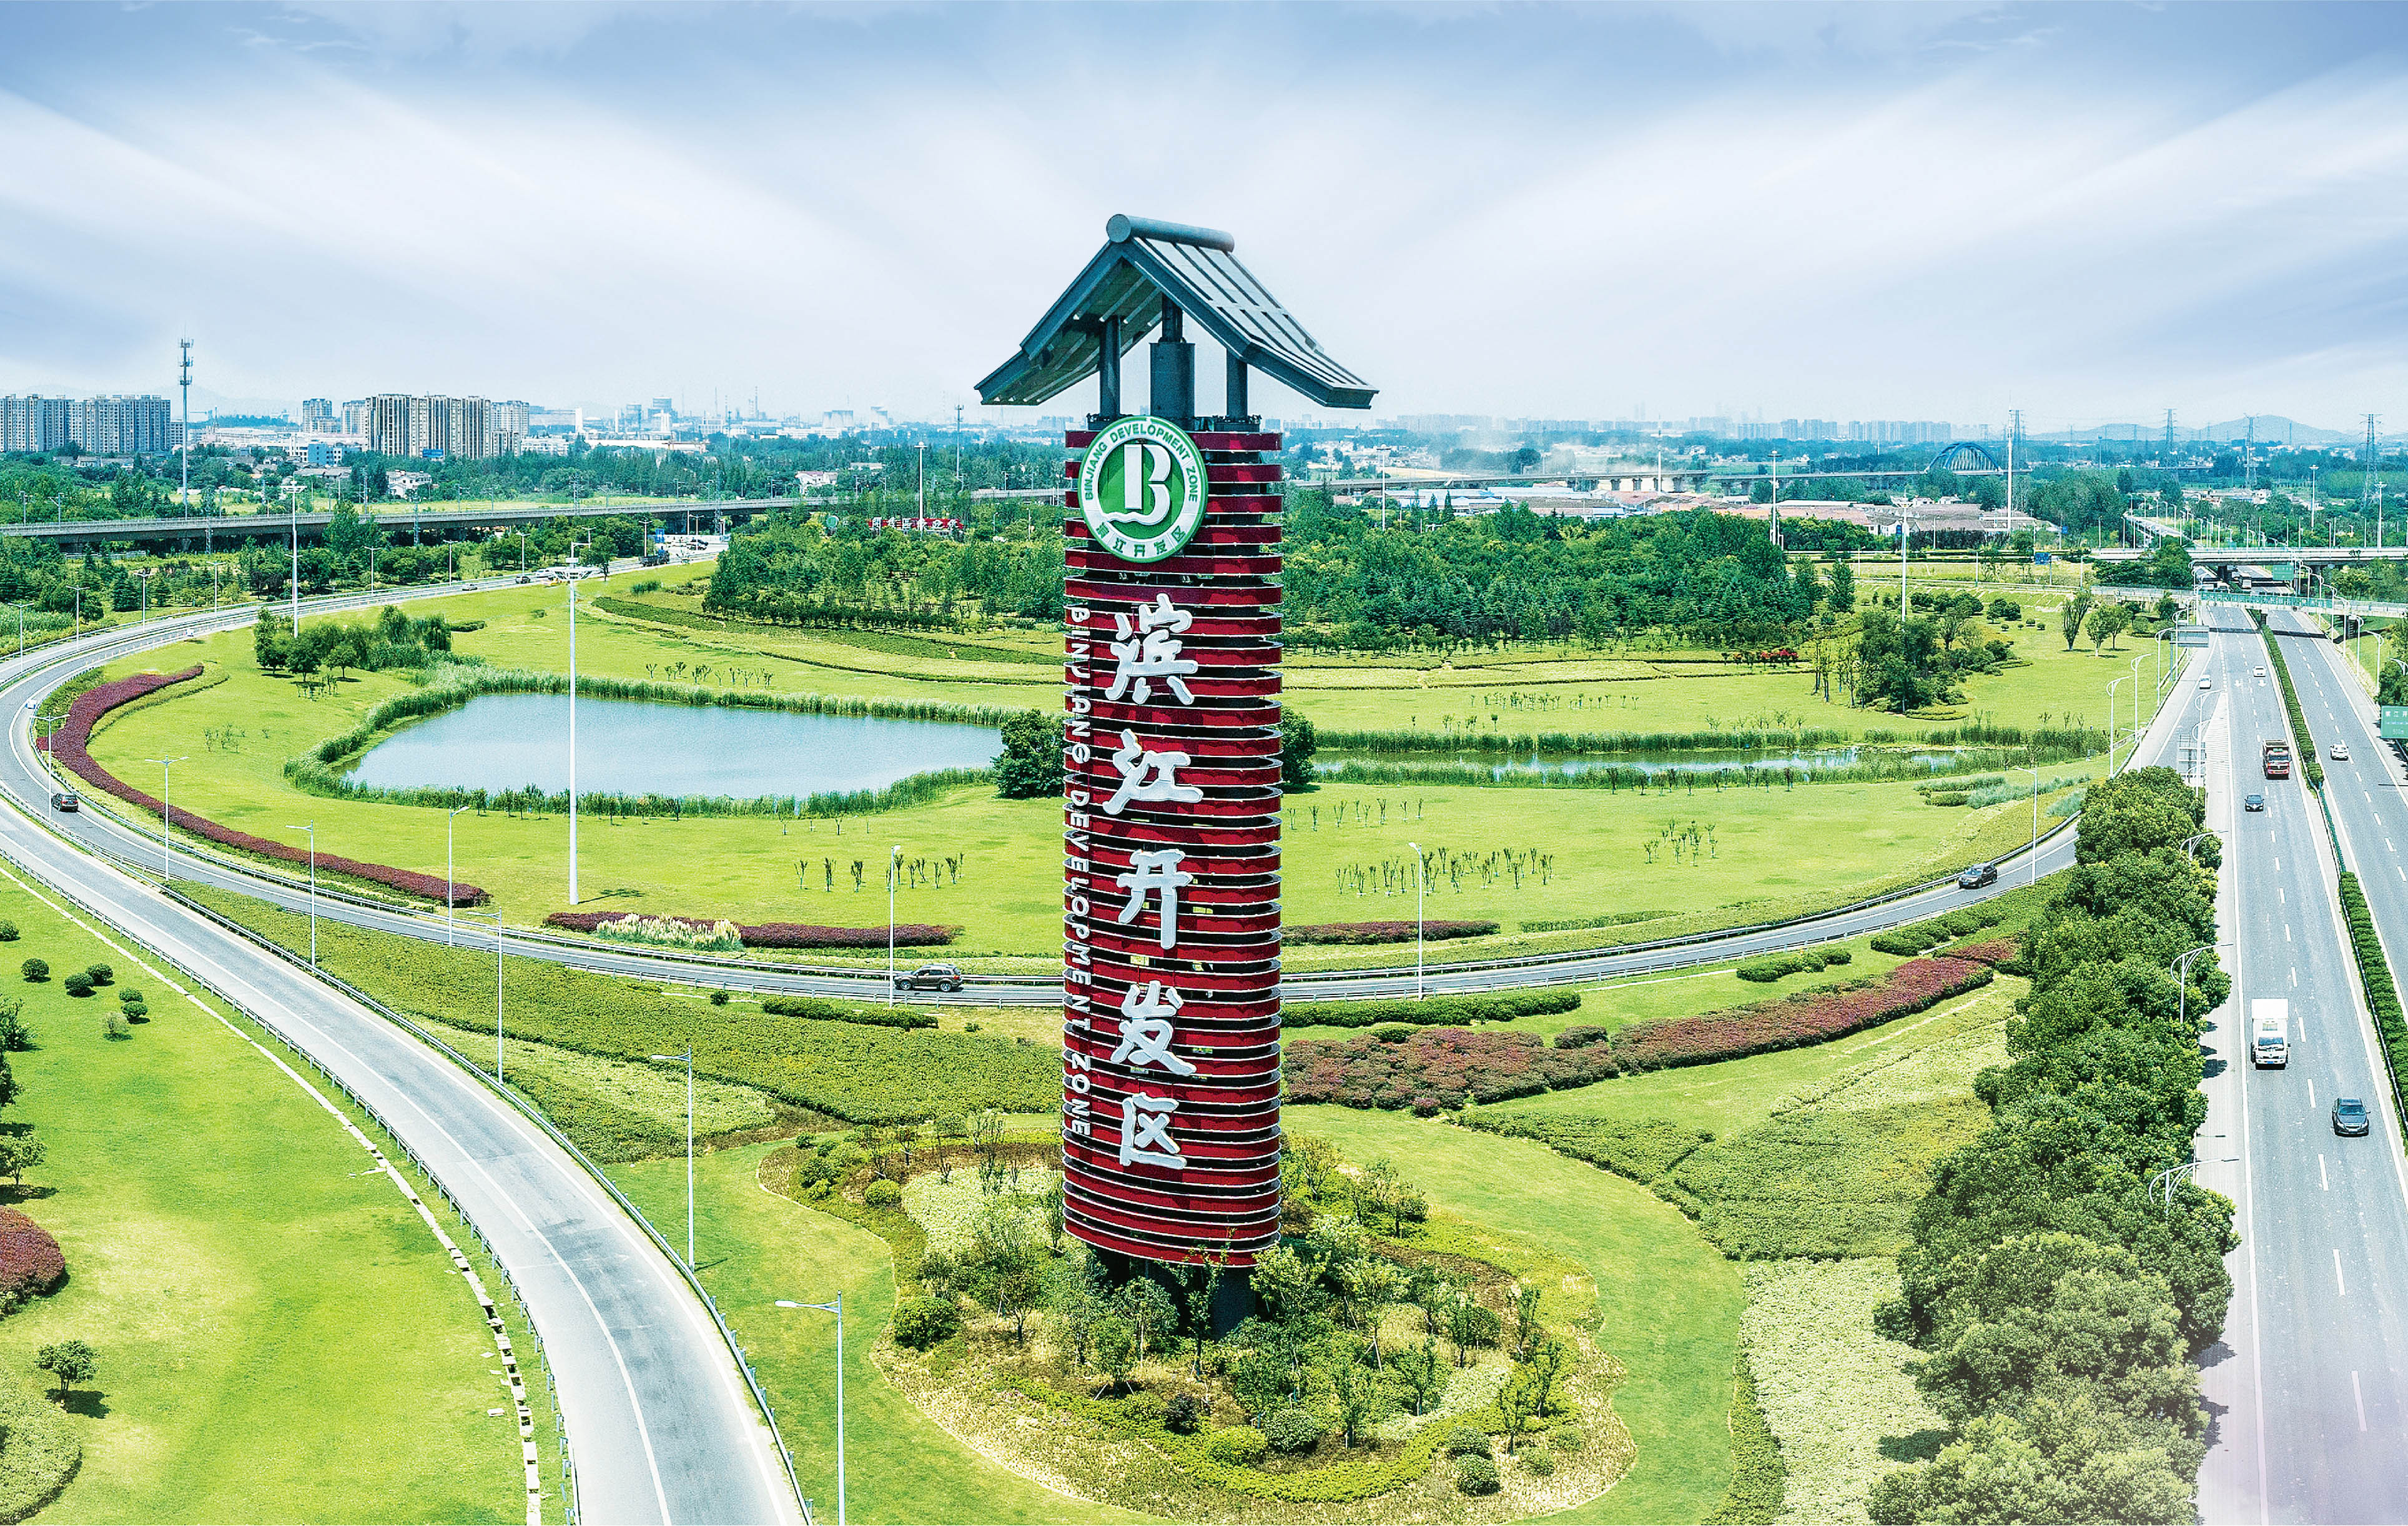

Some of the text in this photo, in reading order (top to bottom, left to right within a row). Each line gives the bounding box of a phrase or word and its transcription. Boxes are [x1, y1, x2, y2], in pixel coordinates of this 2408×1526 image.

[1084, 424, 1199, 503] BINJIANG DEVELOPMENT ZONE
[1070, 607, 1092, 1136] BINJIANG DEVELOPMENT ZONE
[1102, 592, 1204, 1170] 滨江开发区
